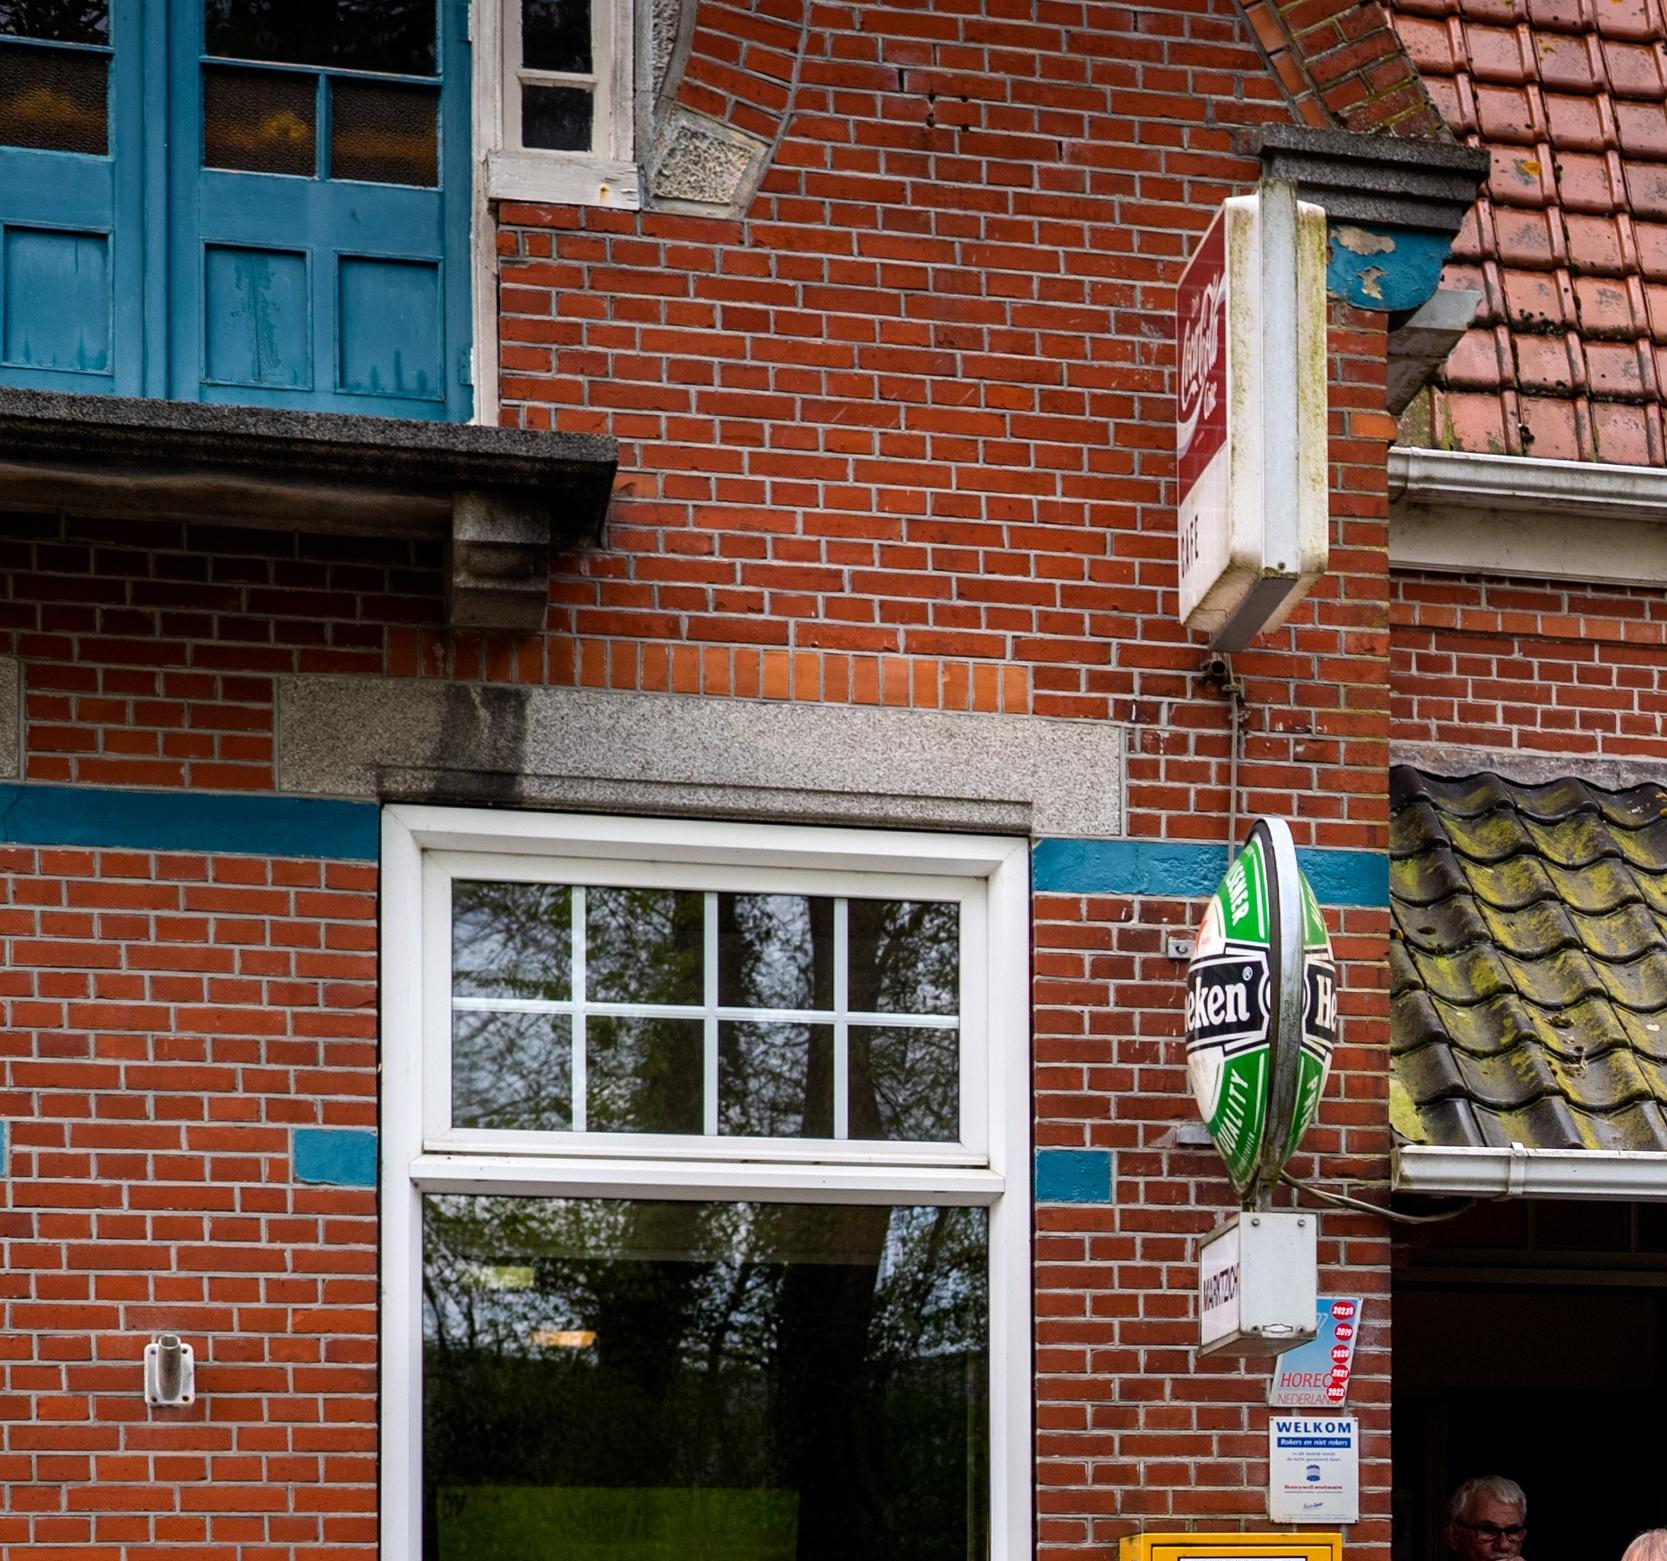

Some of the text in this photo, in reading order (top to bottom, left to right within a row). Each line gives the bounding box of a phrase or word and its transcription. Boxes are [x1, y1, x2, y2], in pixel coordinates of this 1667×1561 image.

[1216, 1067, 1249, 1157] QUALITY
[1280, 1372, 1332, 1388] HOREC
[1276, 1421, 1351, 1433] WELKOM
[1280, 1438, 1303, 1447] Rokers
[1314, 1438, 1327, 1447] niet
